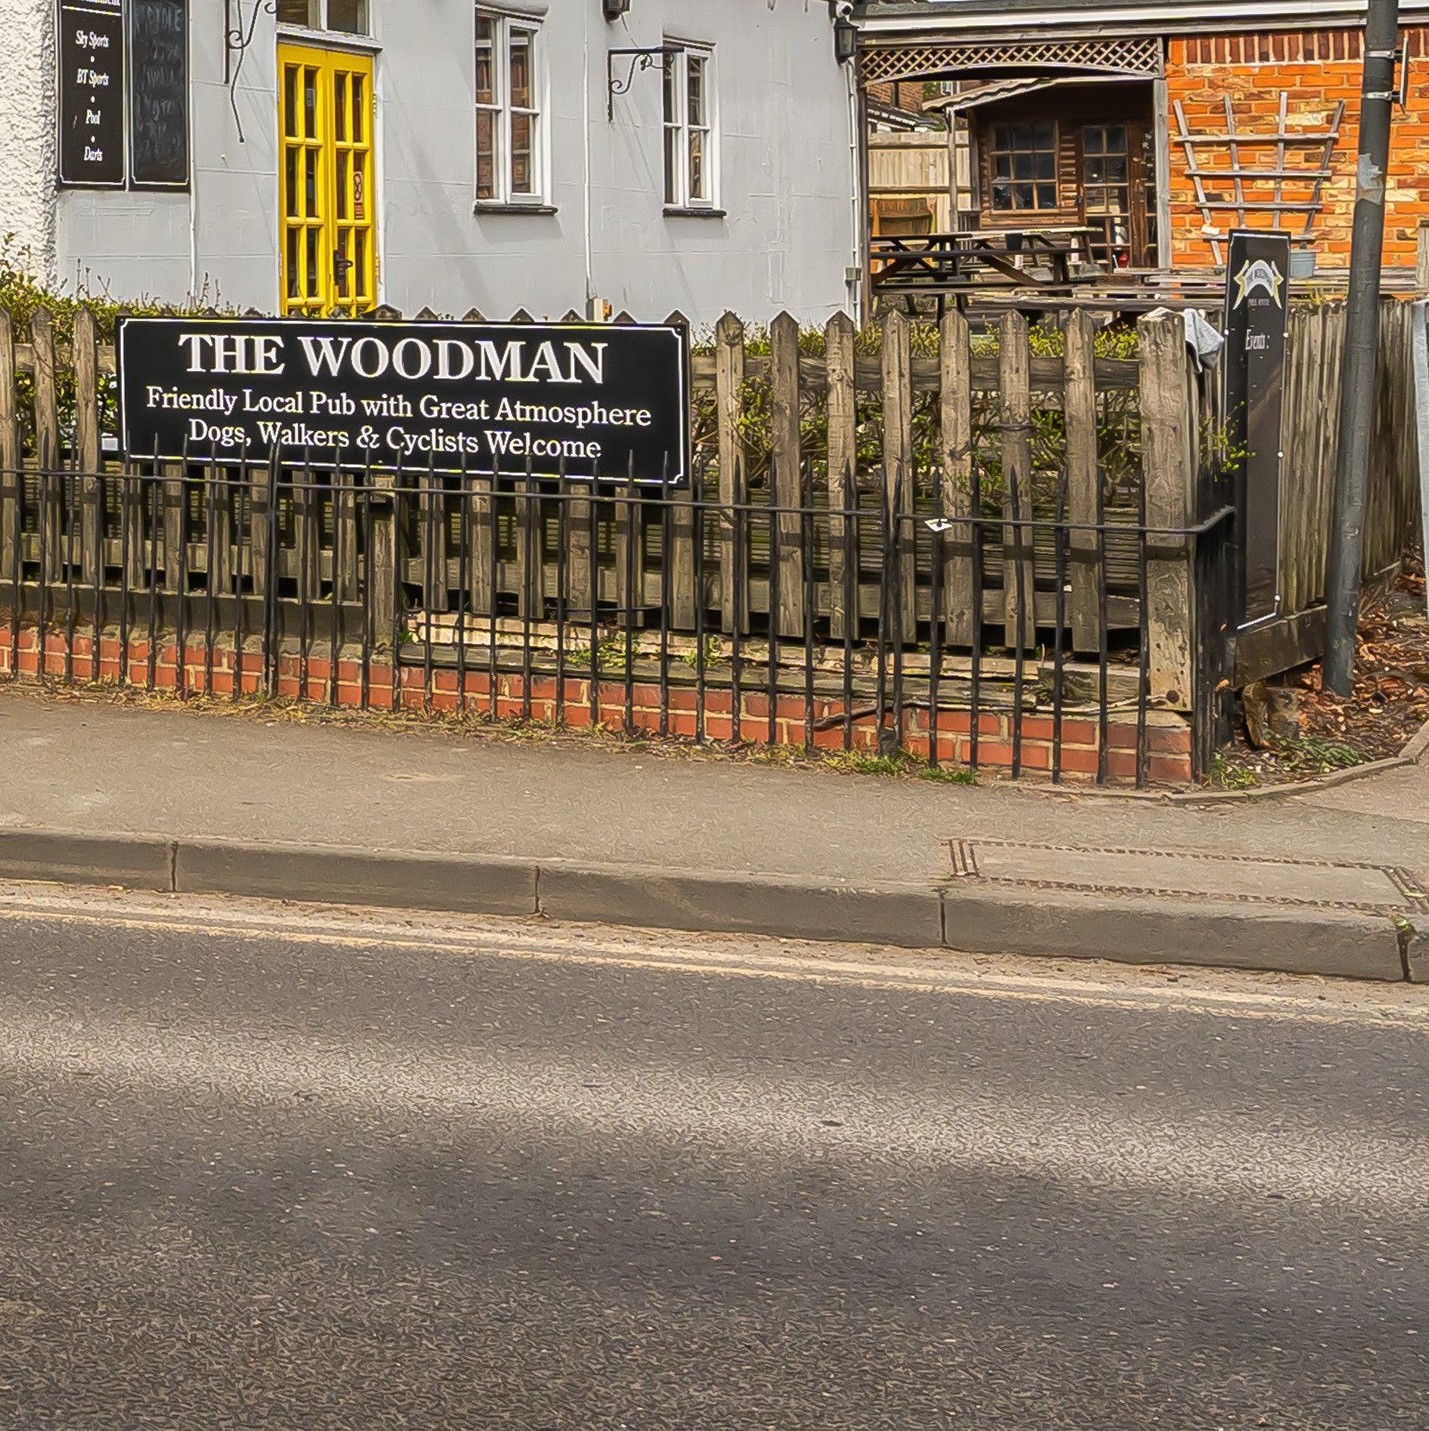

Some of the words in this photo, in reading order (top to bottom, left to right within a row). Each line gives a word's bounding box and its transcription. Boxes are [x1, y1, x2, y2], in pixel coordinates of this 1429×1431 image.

[75, 30, 88, 48] Sky
[89, 31, 109, 49] Sports
[76, 68, 88, 84] BT
[89, 70, 109, 87] Sports
[85, 109, 101, 125] Pool
[83, 146, 103, 161] Darts
[178, 334, 286, 376] THE
[297, 336, 608, 384] WOODMAN
[147, 386, 238, 415] Friendly
[243, 389, 303, 414] Local
[310, 391, 355, 416] Pub
[361, 395, 412, 417] with
[419, 395, 490, 420] Great
[495, 399, 652, 427] Atmosphere
[189, 419, 251, 447] Dogs,
[258, 422, 350, 449] Walkers
[355, 426, 380, 449] &
[386, 427, 478, 455] Cyclists
[483, 431, 601, 459] Welcome
